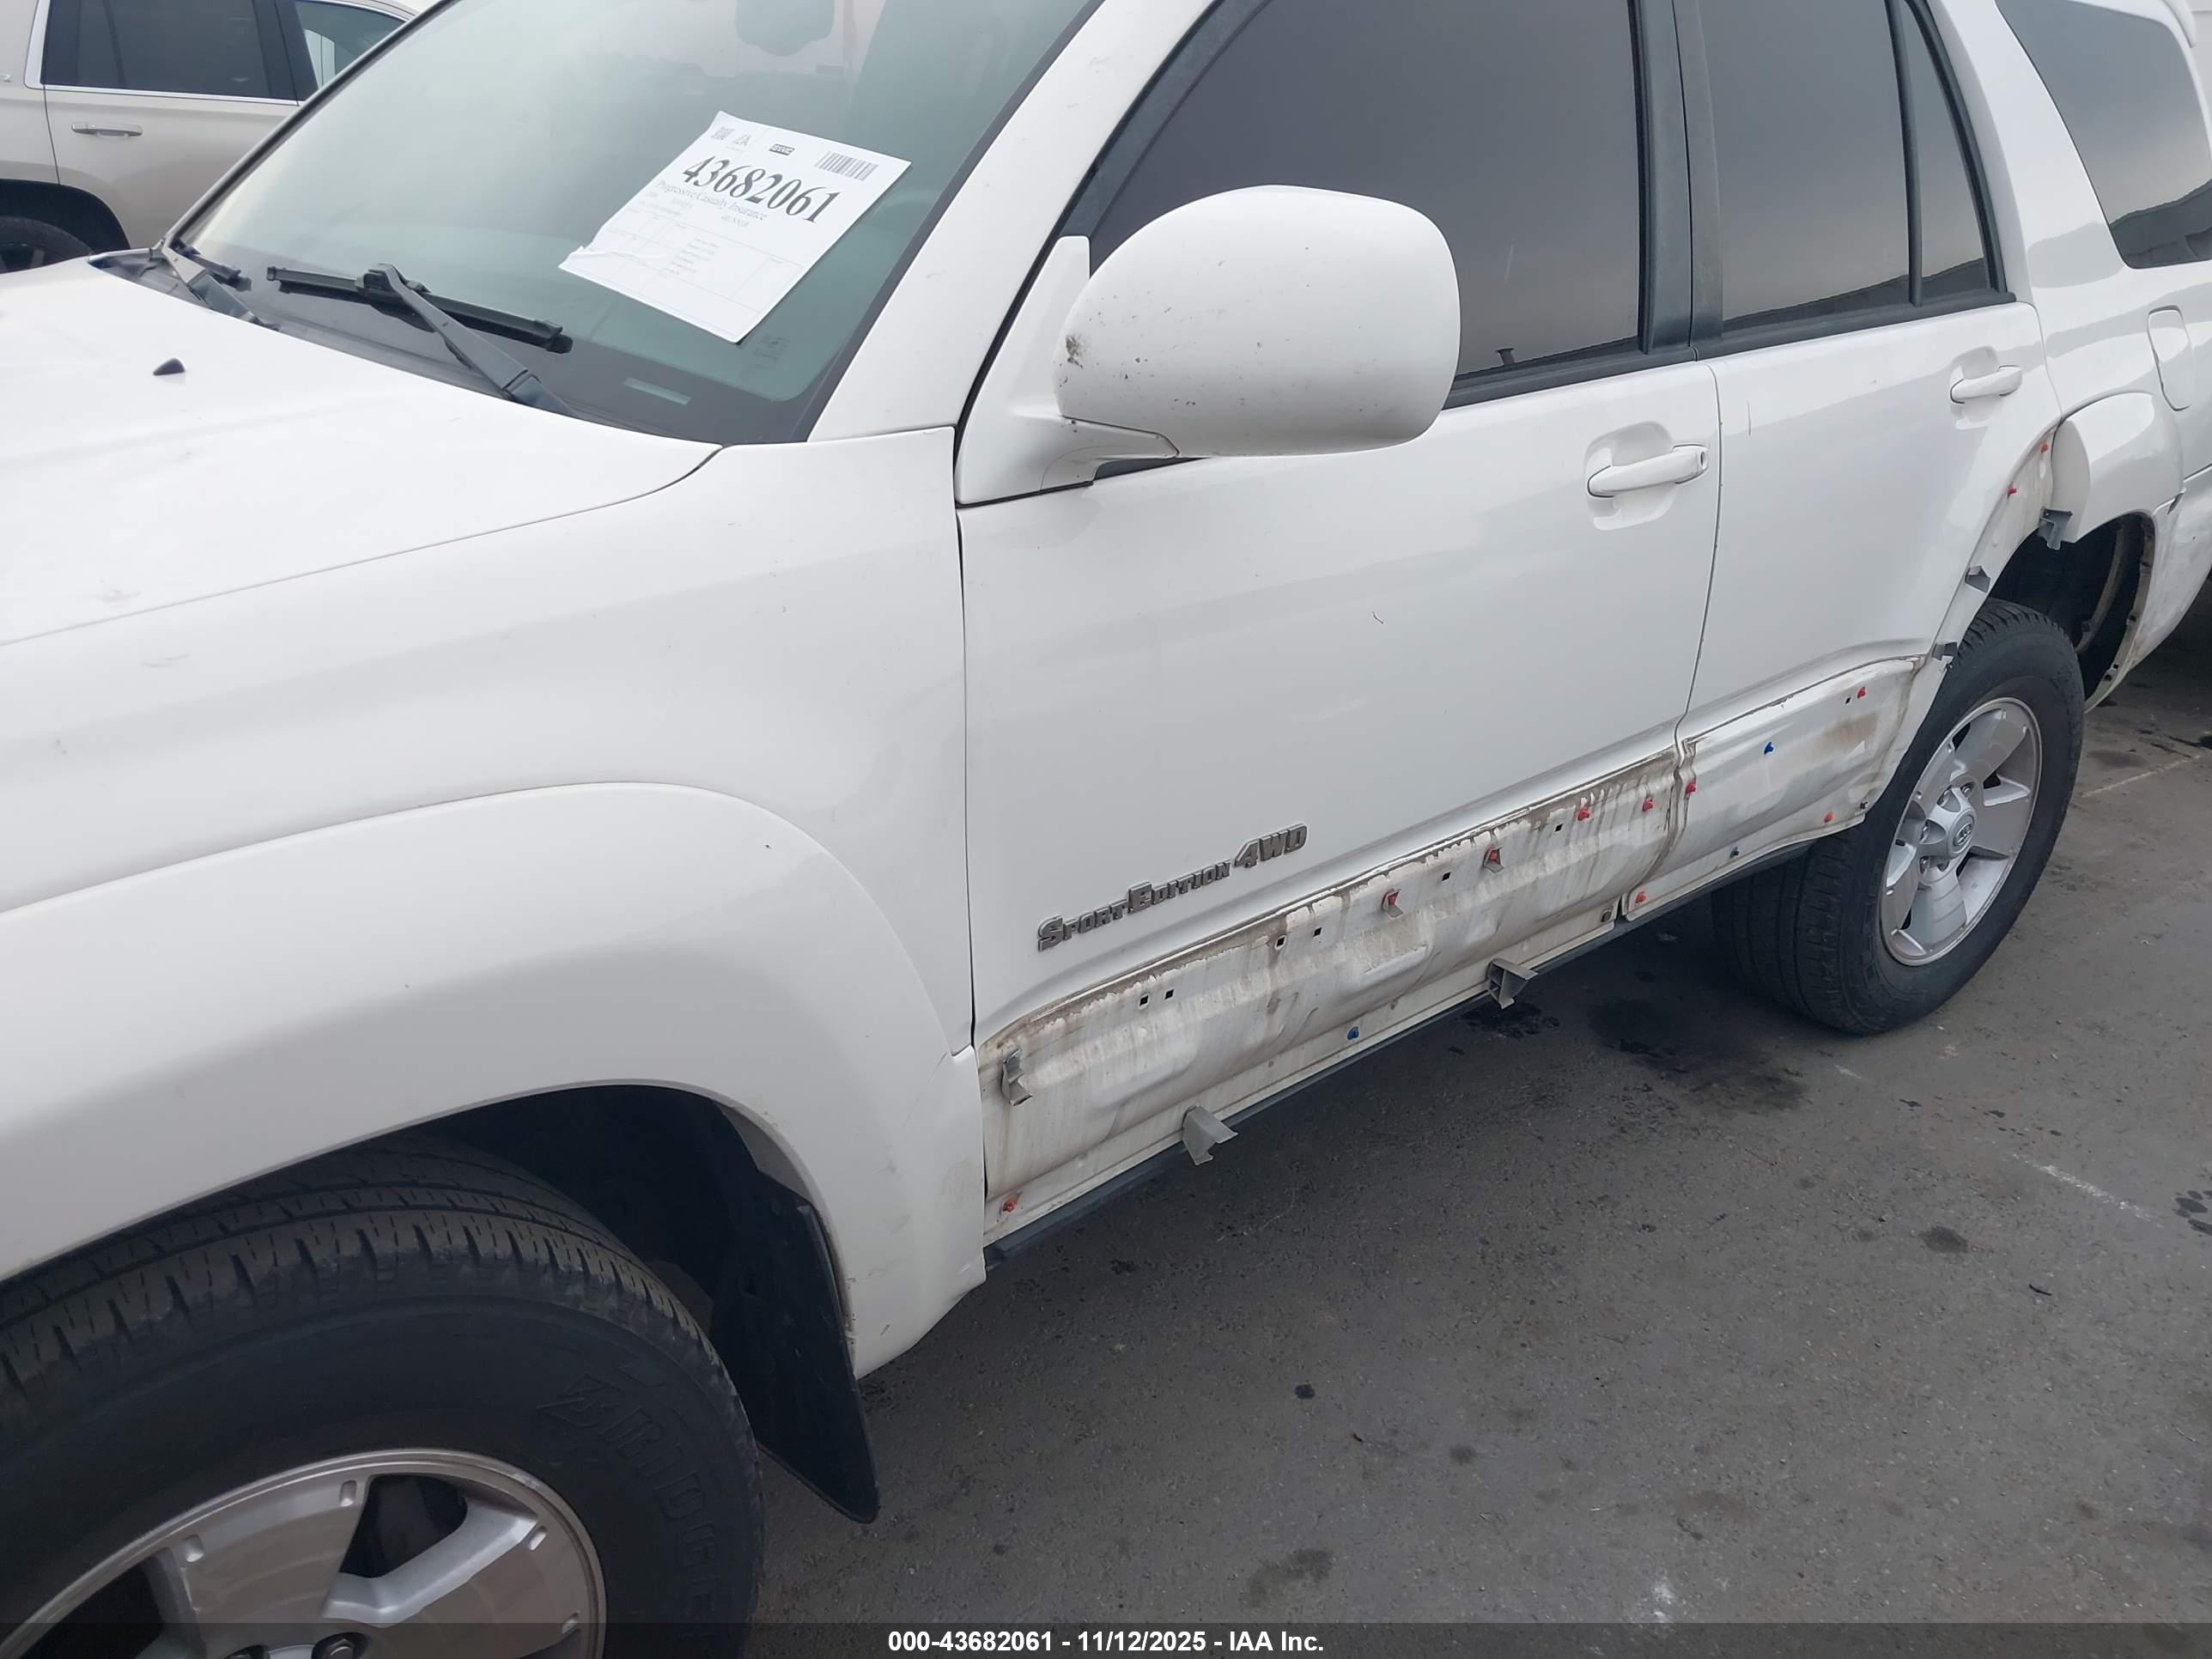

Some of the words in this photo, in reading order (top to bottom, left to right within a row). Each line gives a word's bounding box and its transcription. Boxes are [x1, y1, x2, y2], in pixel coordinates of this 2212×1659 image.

[682, 156, 841, 223] 43682061
[728, 201, 768, 221] Insurance
[1234, 823, 1308, 868] 4WD
